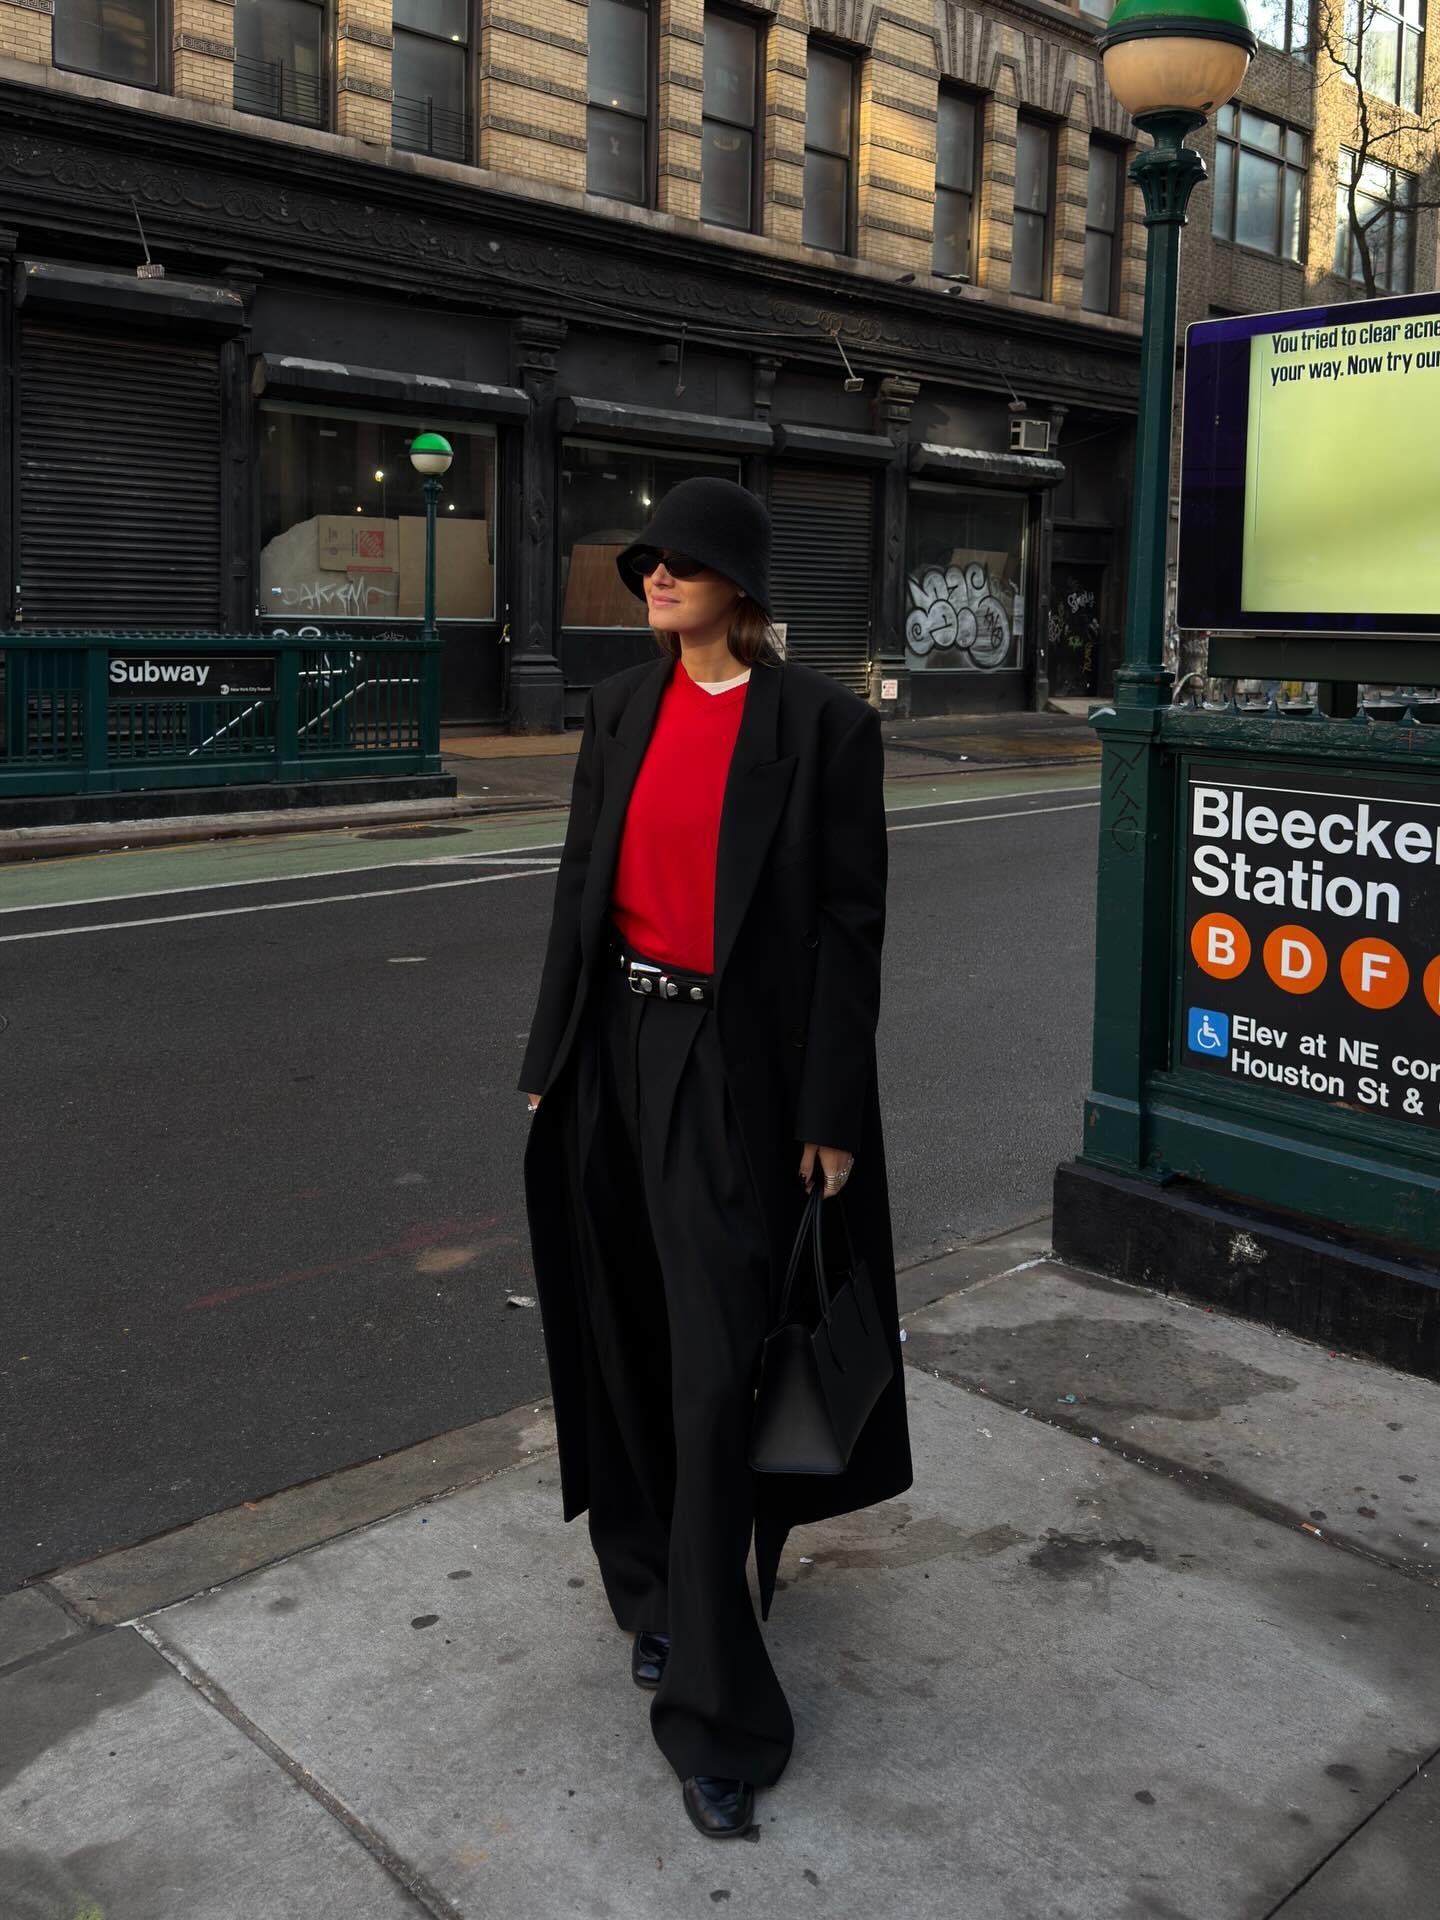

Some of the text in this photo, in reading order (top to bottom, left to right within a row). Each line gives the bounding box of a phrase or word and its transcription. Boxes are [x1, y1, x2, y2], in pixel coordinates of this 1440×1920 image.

[1271, 364, 1306, 386] your
[1309, 361, 1344, 380] way.
[1347, 355, 1383, 375] Now
[1387, 351, 1413, 374] try
[1272, 334, 1298, 354] You
[1302, 328, 1338, 350] tried
[1341, 327, 1357, 346] to
[1360, 324, 1401, 344] clear
[109, 660, 210, 686] Subway
[1193, 787, 1440, 865] Bleecke
[1192, 845, 1400, 924] Station
[1207, 926, 1236, 966] B
[1281, 939, 1312, 979] D
[1361, 952, 1391, 992] F
[1232, 1014, 1287, 1049] Elev
[1300, 1034, 1327, 1058] at
[1339, 1037, 1379, 1070] NE
[1231, 1048, 1424, 1115] Houston St &
